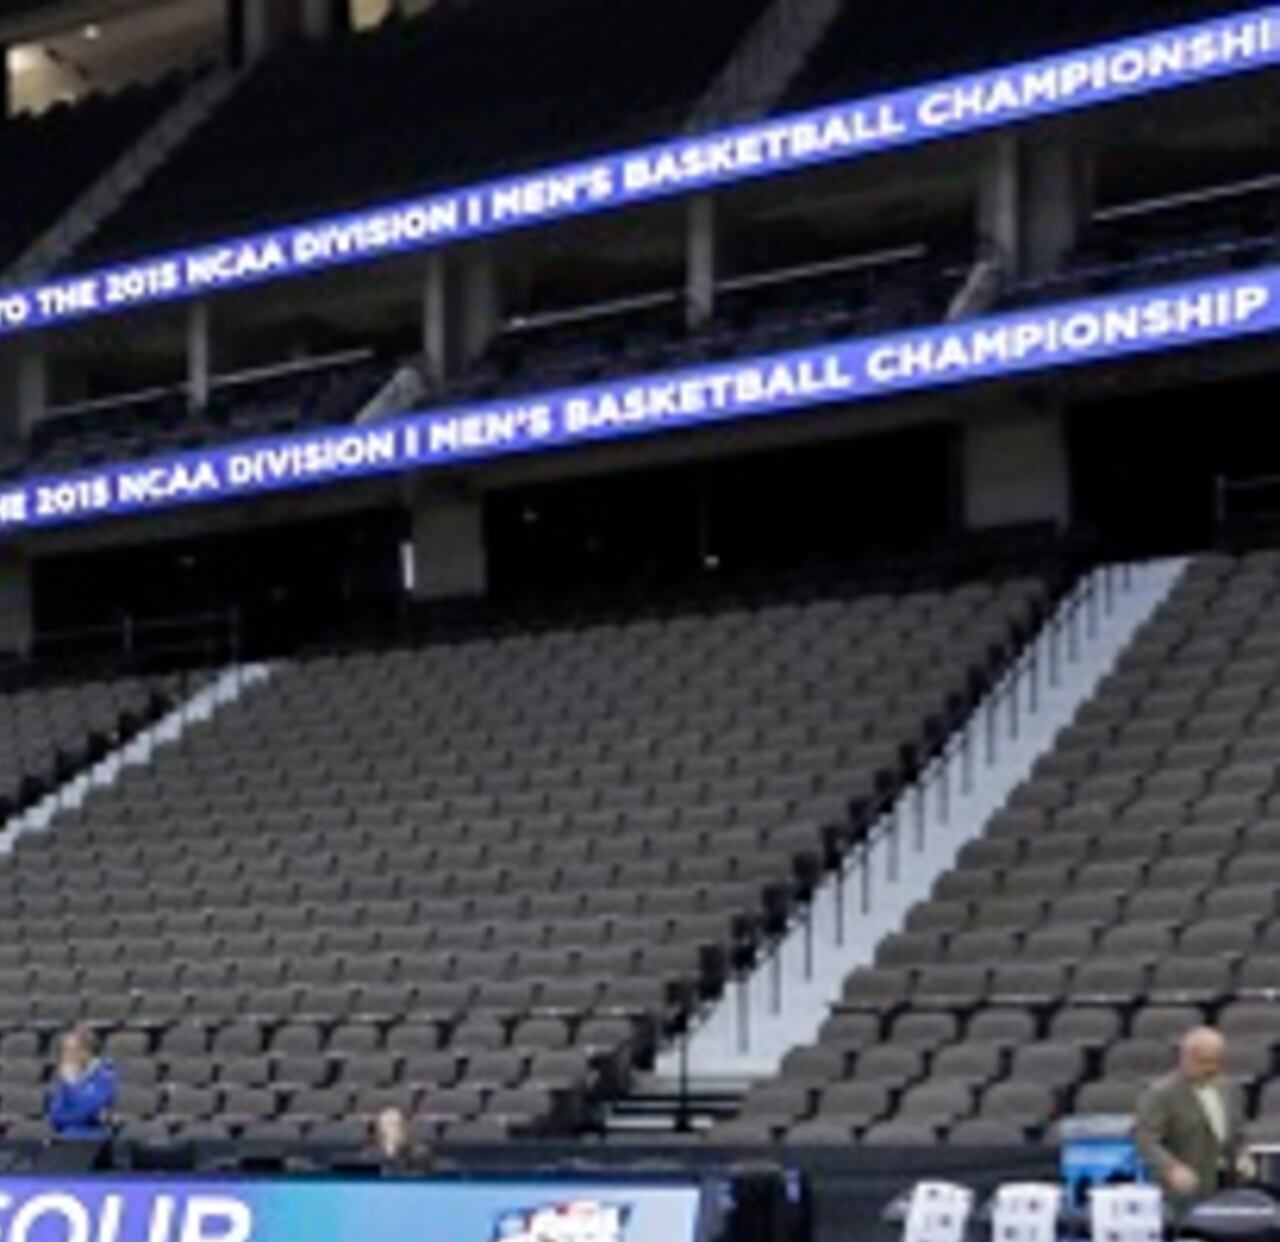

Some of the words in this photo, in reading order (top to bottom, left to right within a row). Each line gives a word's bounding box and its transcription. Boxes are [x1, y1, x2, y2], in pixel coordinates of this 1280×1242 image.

[36, 280, 97, 316] THE
[105, 261, 178, 301] 2015
[186, 238, 285, 284] NCAA
[293, 198, 458, 264] DIVISION
[467, 194, 483, 227] I
[623, 104, 906, 190] BASKETBALL
[916, 19, 1280, 127] CHAMPIONSHI
[35, 474, 108, 516] 2015
[116, 454, 220, 502] NCAA
[228, 430, 394, 488] DIVISION
[404, 426, 420, 459] I
[564, 354, 852, 435] BASKETBALL
[865, 285, 1270, 381] CHAMPIONSHIP
